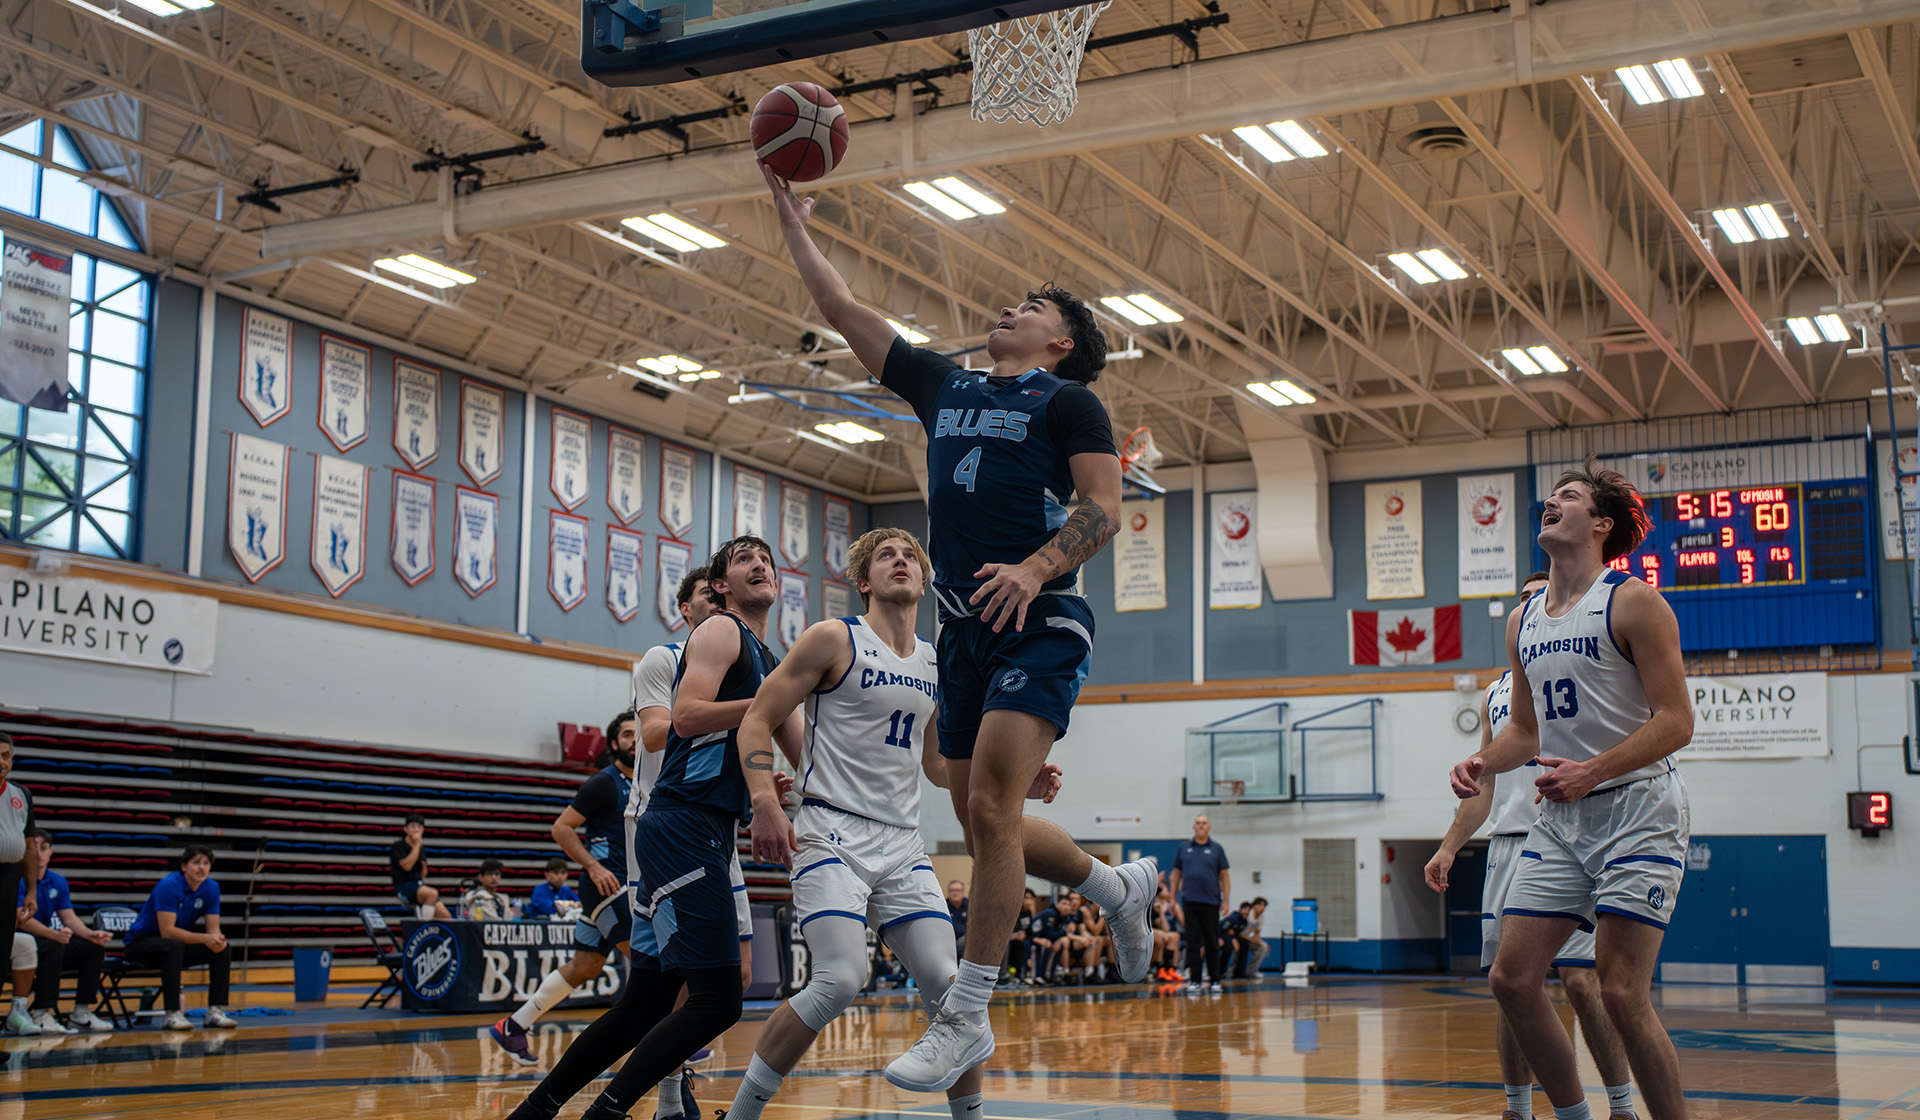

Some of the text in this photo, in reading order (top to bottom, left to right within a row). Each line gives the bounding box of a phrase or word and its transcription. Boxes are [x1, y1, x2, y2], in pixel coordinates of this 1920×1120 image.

[935, 409, 1031, 442] BLUES
[953, 446, 982, 493] 4
[1671, 457, 1745, 473] CAPILANO
[1677, 490, 1733, 521] 5:15
[1756, 502, 1790, 532] 60
[1681, 527, 1735, 549] period 3
[1371, 549, 1419, 559] CHAMPIONS
[1642, 554, 1660, 569] TOL
[1679, 552, 1717, 567] PLAYER
[1736, 550, 1755, 563] TOL
[1770, 547, 1791, 561] FLS
[1646, 562, 1793, 588] 3 3 1
[0, 579, 154, 625] PILANO
[1522, 636, 1600, 669] CAMOSUN
[1542, 678, 1579, 721] 13
[1695, 685, 1796, 705] PILANO
[884, 709, 916, 750] 11
[1869, 794, 1888, 824] 2
[483, 924, 543, 946] CAPILANO
